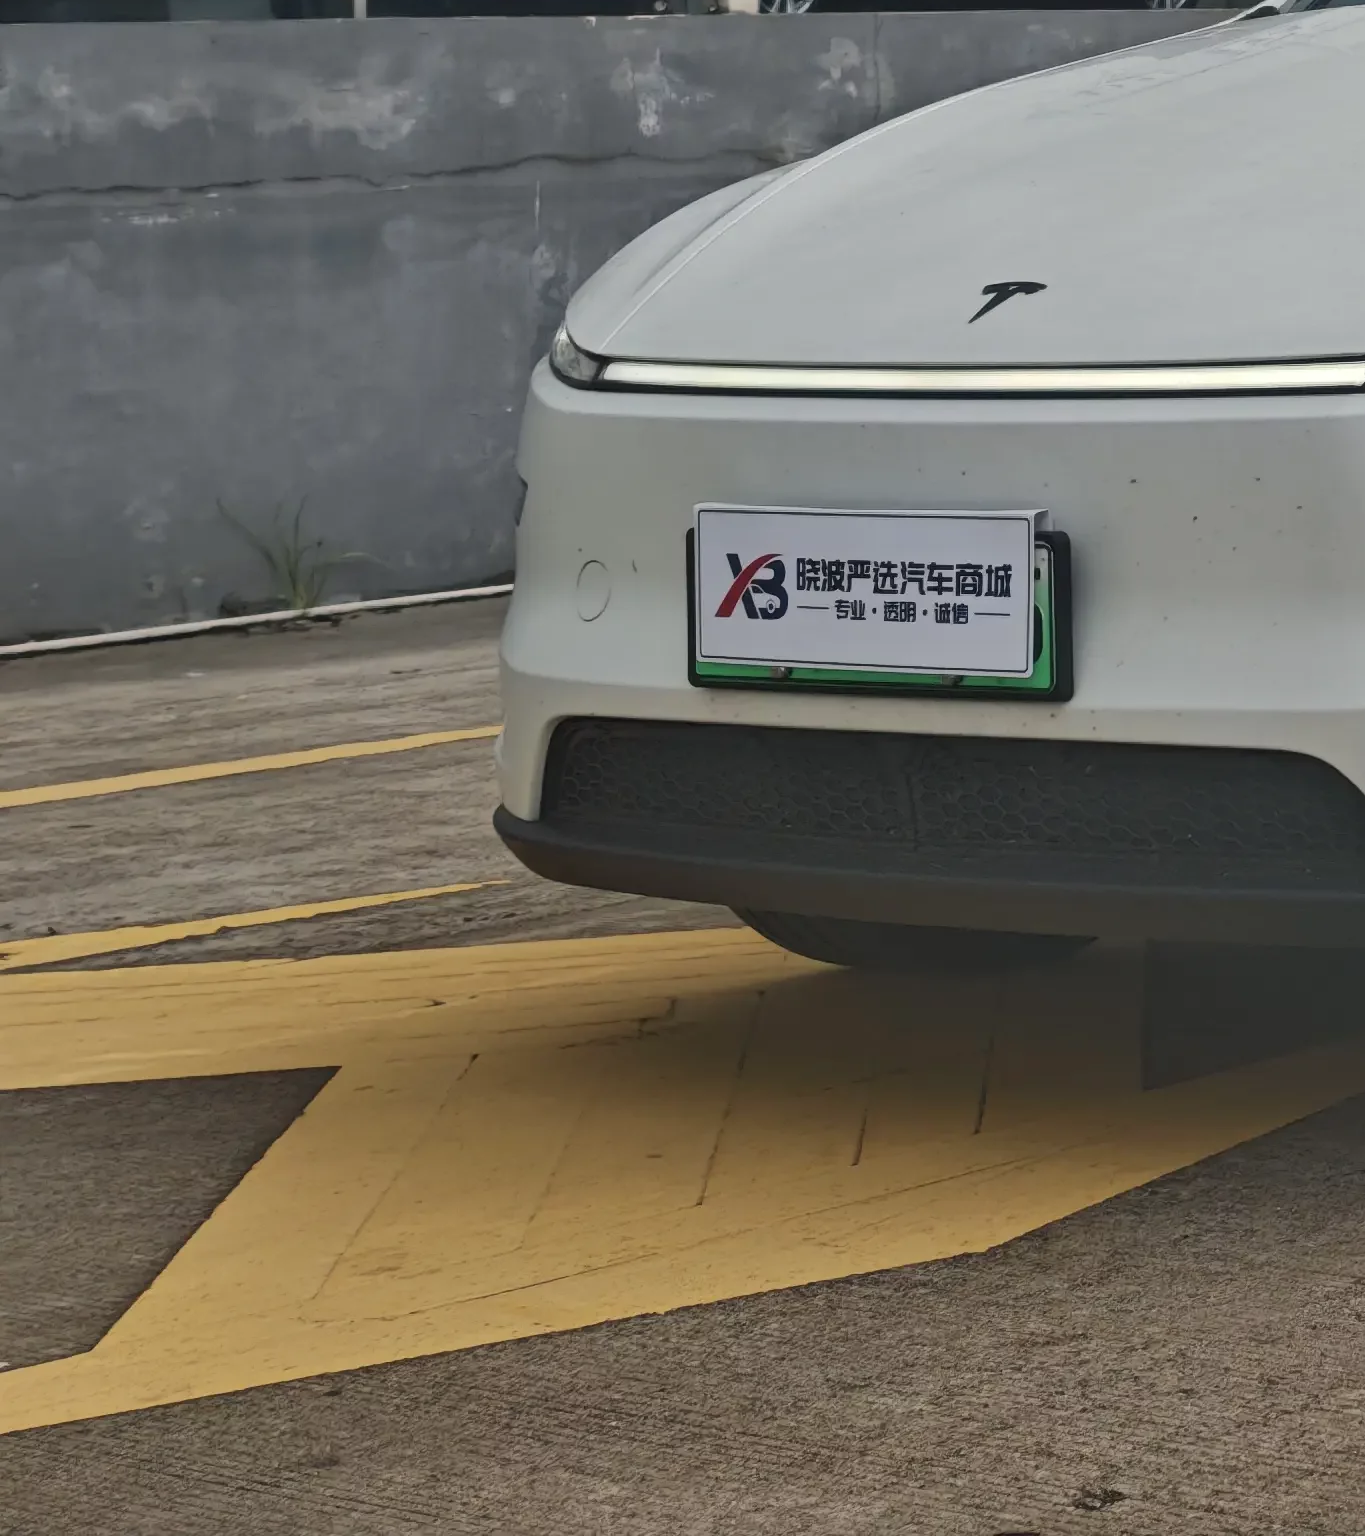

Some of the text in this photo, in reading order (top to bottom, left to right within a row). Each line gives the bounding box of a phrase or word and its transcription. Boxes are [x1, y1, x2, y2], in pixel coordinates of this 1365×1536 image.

[796, 557, 1013, 598] 晓波严选汽车商城
